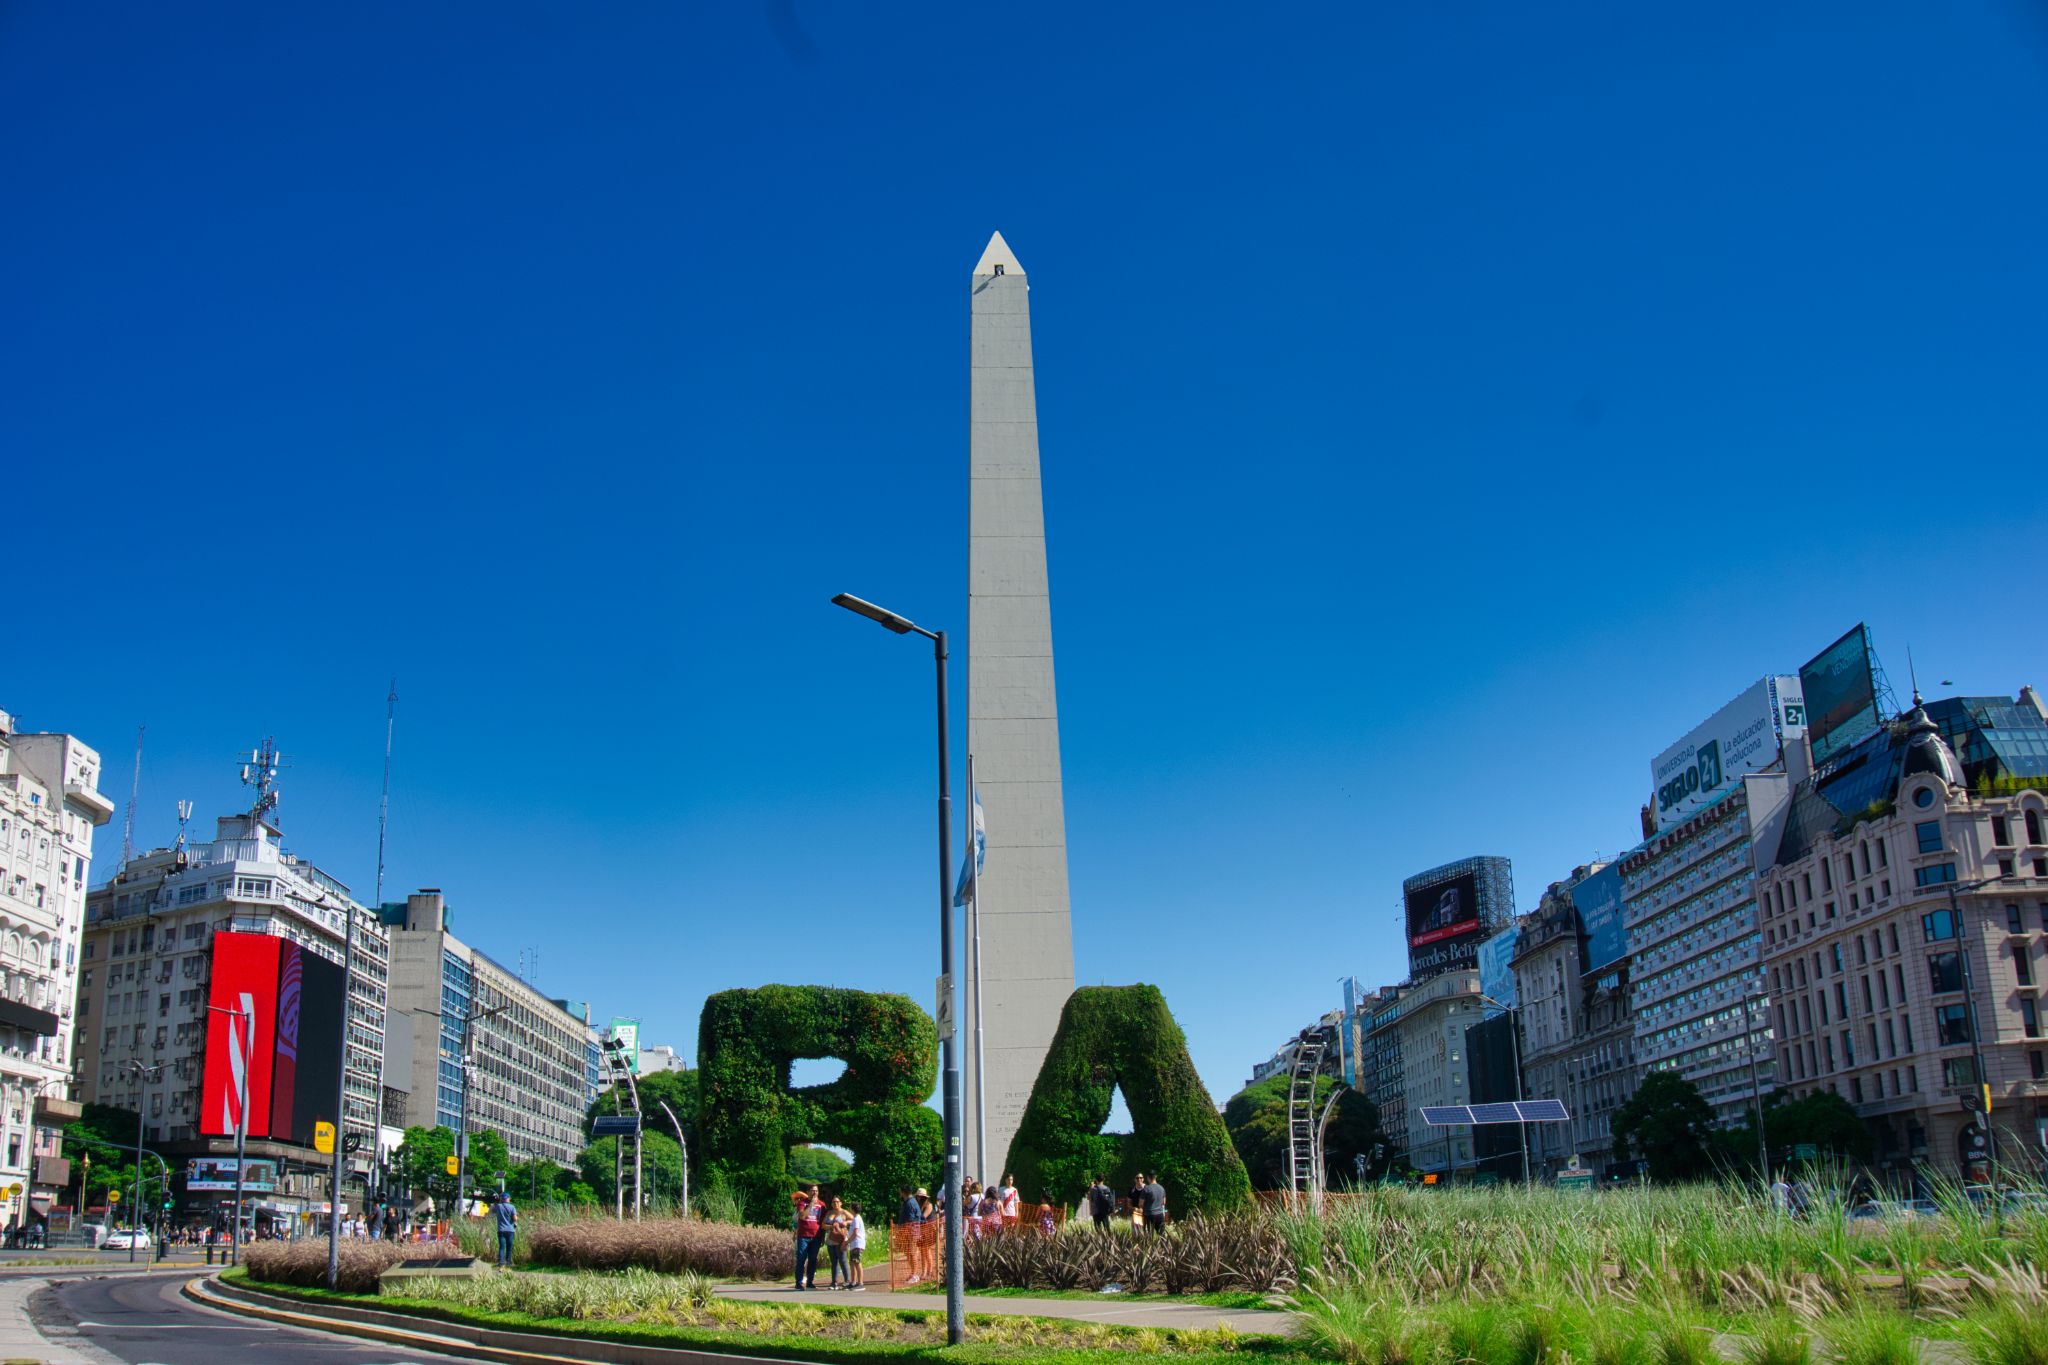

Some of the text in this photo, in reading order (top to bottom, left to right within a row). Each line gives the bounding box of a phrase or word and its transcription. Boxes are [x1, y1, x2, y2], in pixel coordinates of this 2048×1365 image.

[1787, 709, 1803, 725] 21
[1723, 717, 1767, 754] La educación
[1725, 738, 1762, 768] evoluciona
[1657, 744, 1695, 779] UNIVERSIDAD
[1658, 753, 1718, 812] SIGLO 21
